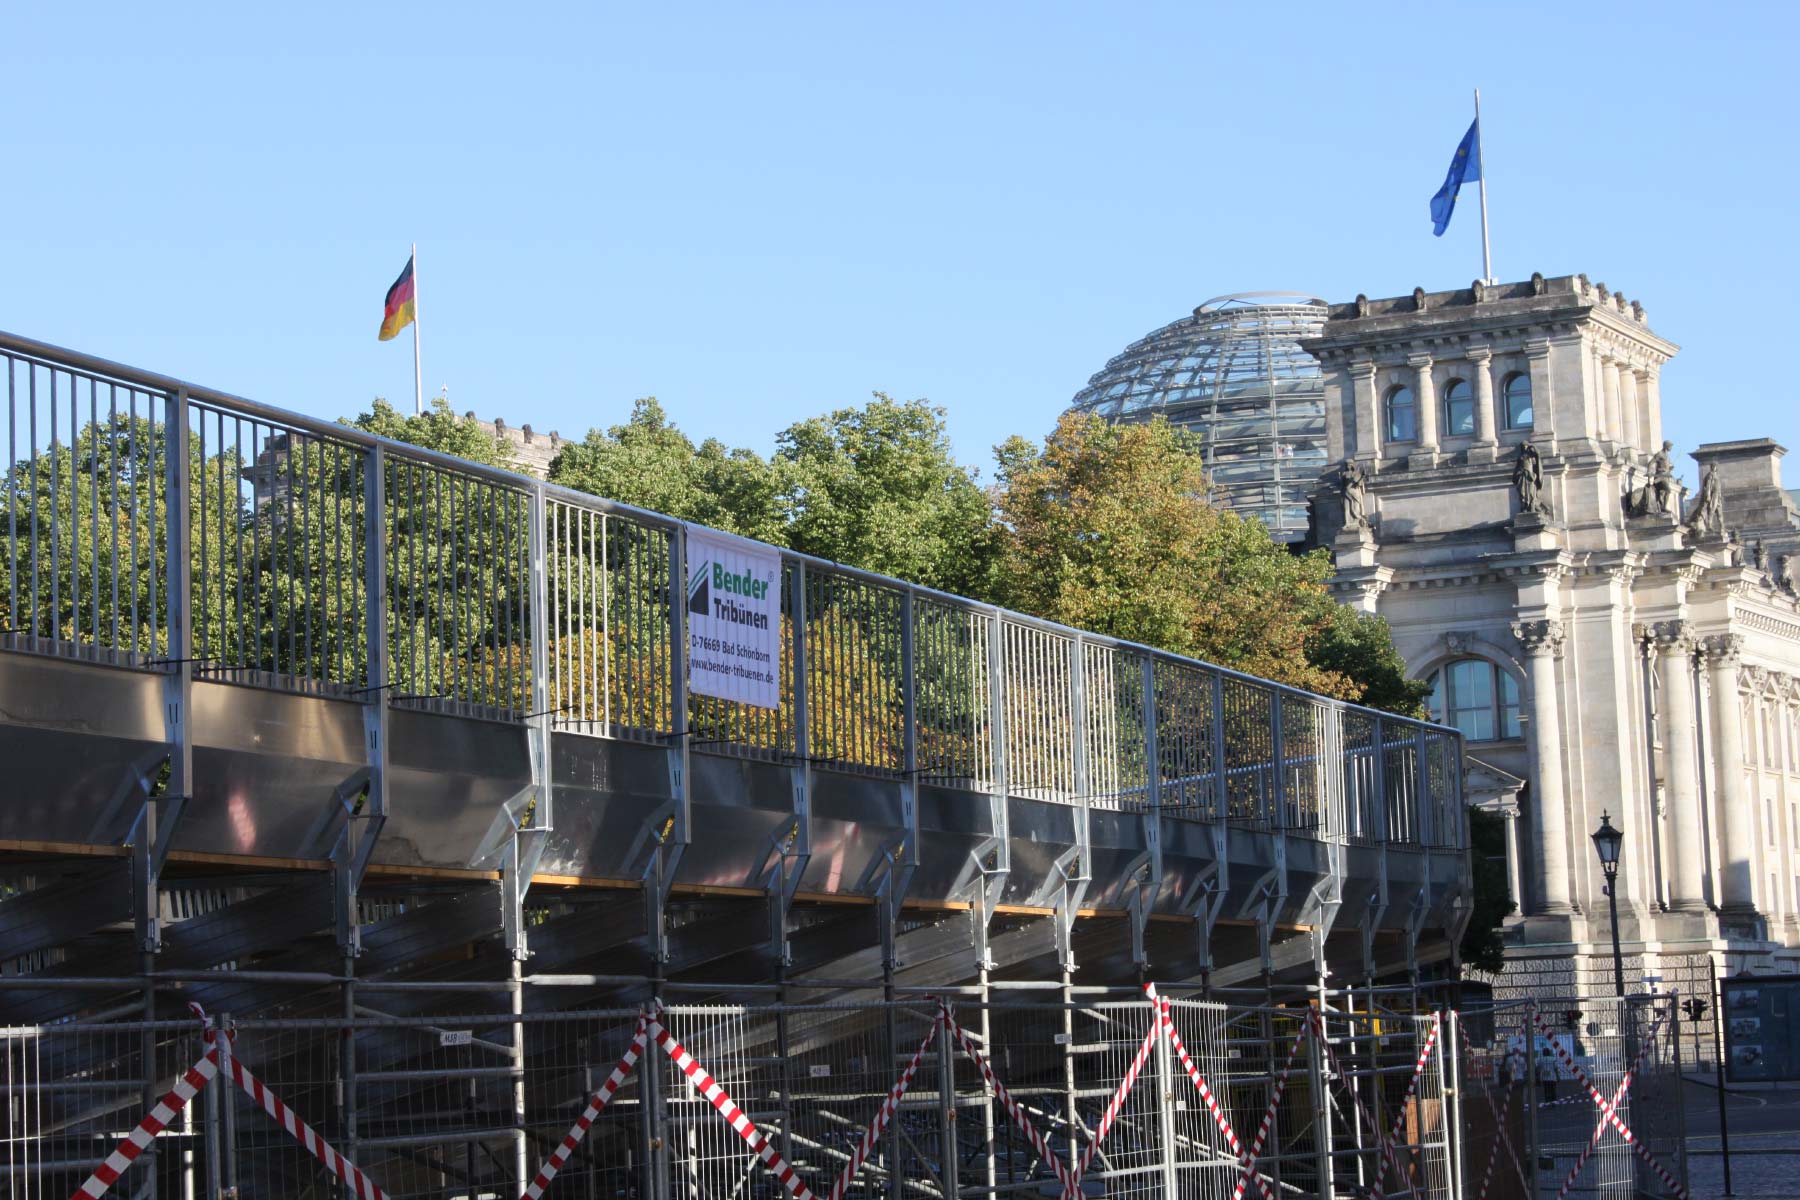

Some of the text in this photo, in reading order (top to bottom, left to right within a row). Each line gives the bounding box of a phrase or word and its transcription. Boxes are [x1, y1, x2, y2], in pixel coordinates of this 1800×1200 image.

[713, 563, 768, 600] Bender
[714, 598, 768, 630] Tribünen
[692, 635, 770, 663] D-76669 Bad Schönborn
[691, 659, 774, 684] www.bender-tribuenen.de
